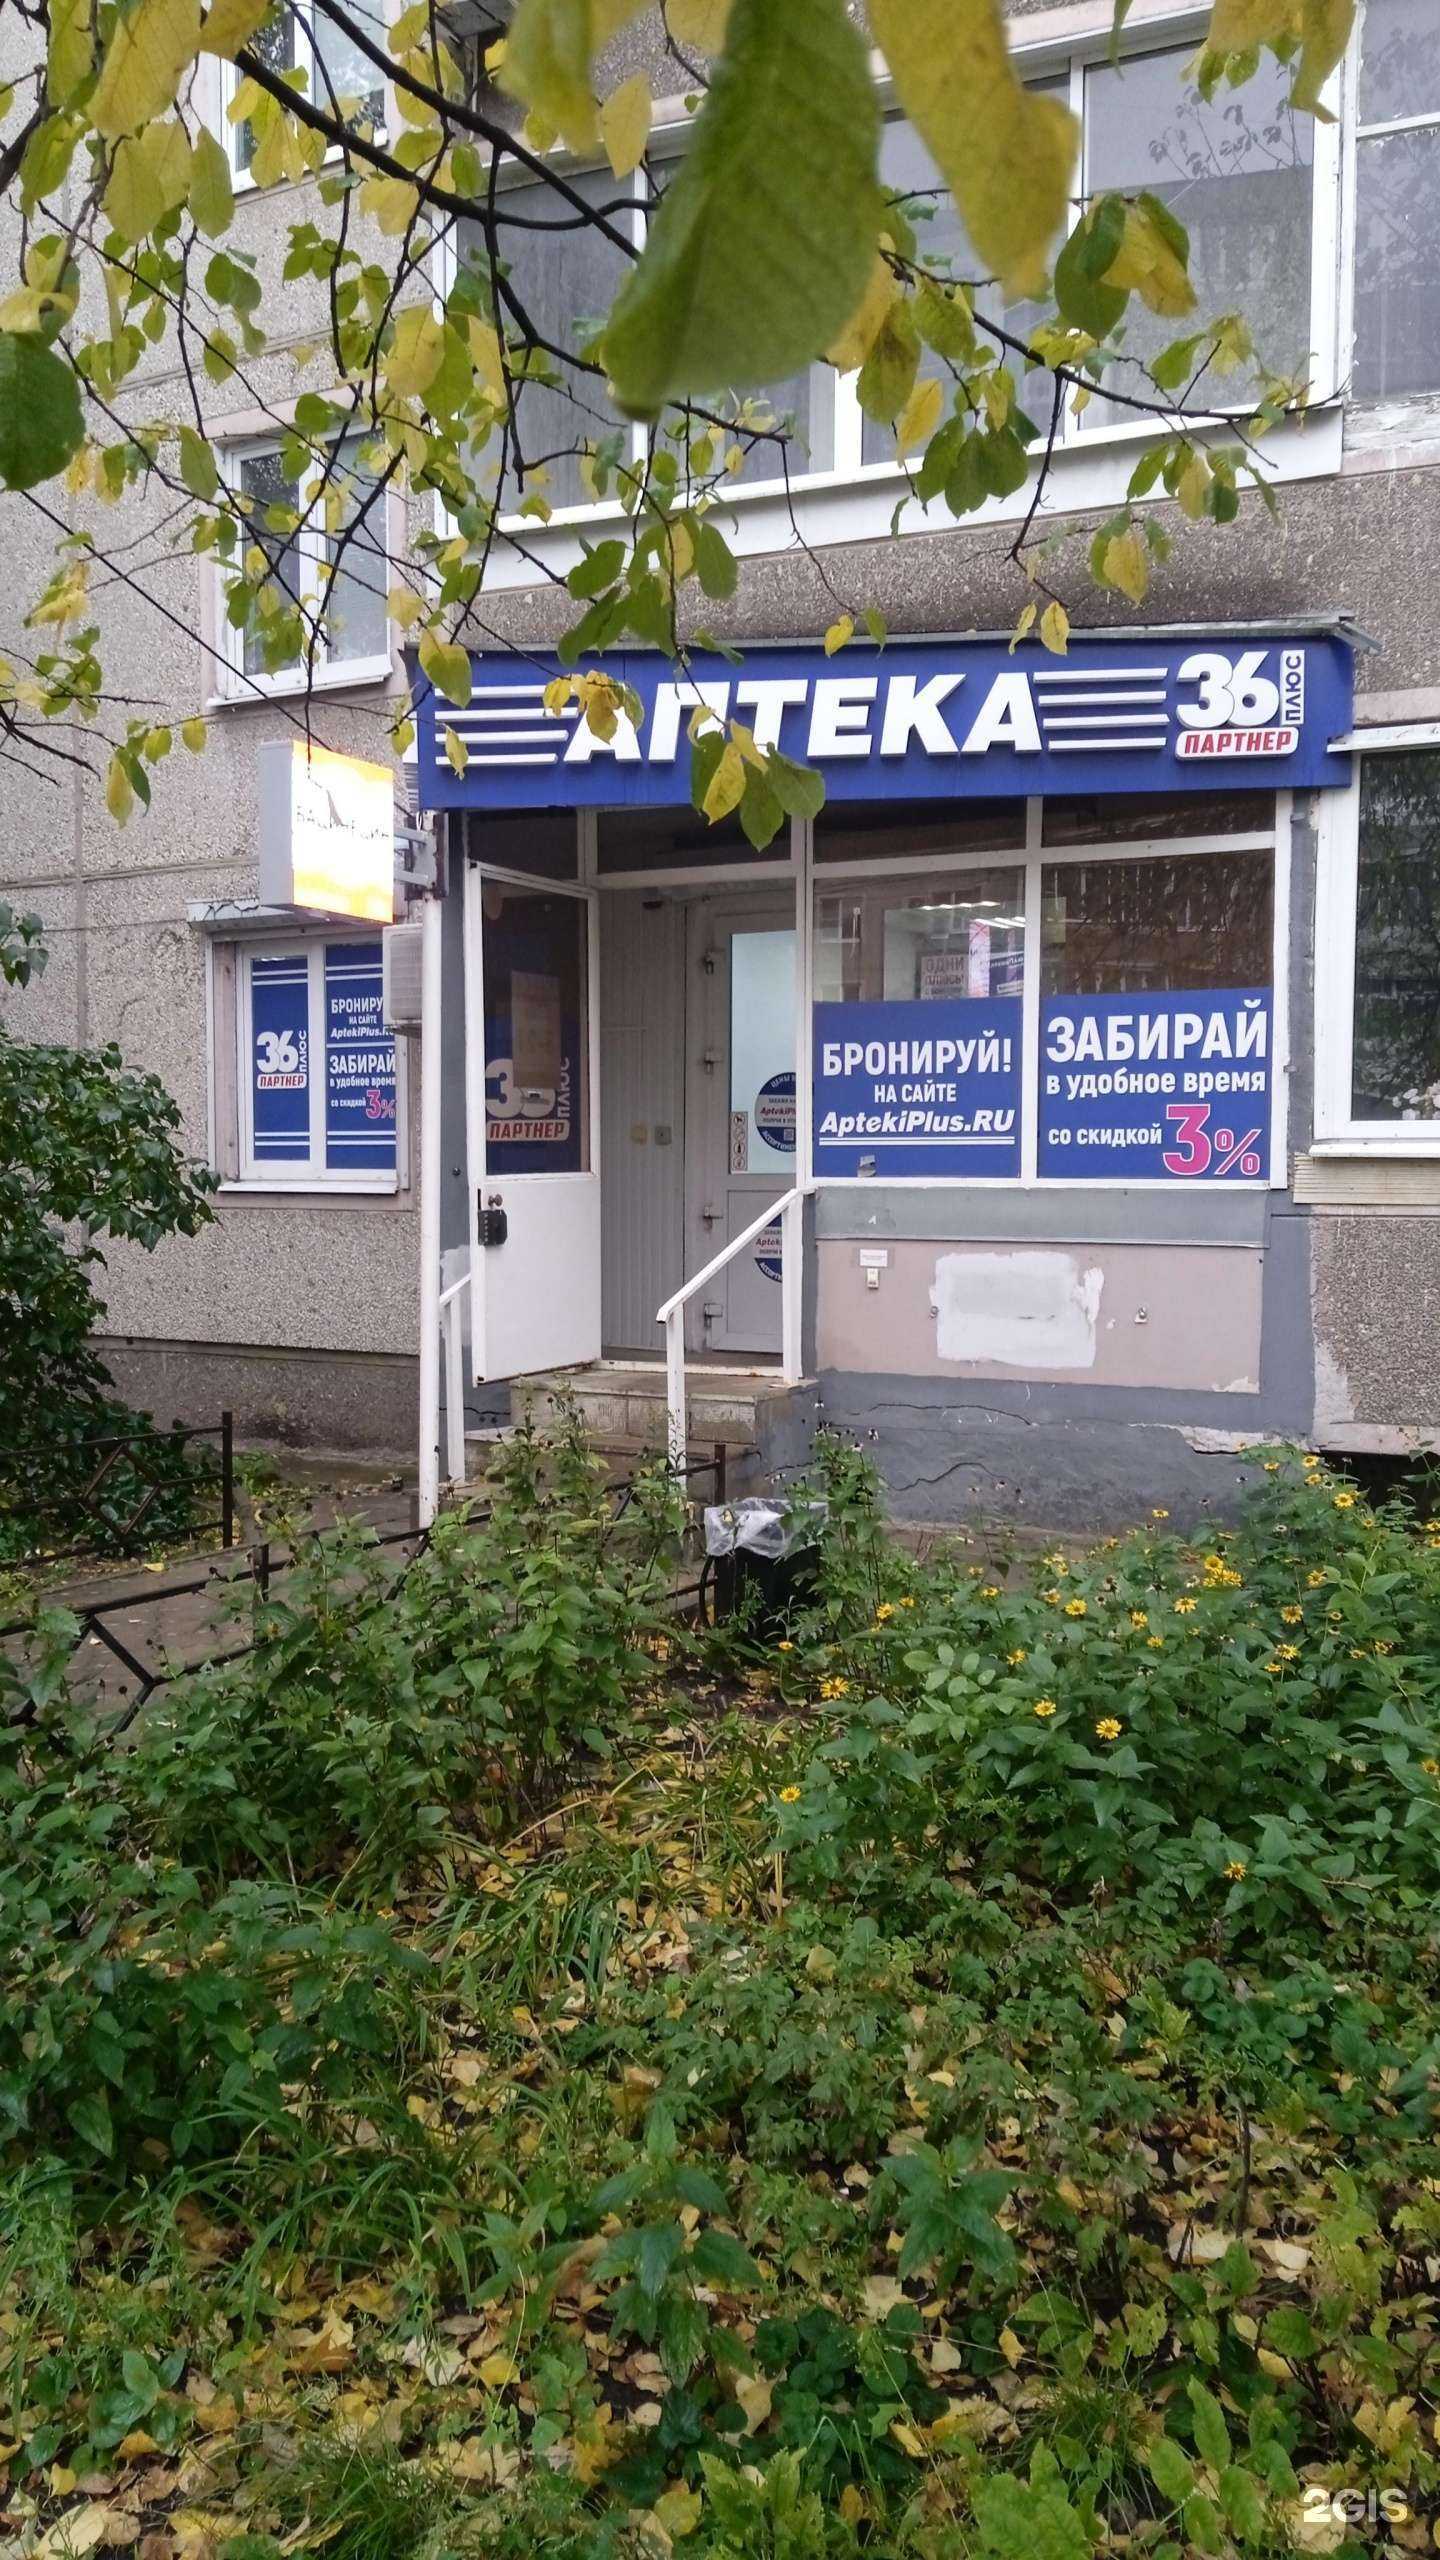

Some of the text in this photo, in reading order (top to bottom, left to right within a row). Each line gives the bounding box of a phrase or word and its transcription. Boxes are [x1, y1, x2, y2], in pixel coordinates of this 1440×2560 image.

[1176, 651, 1280, 729] 36
[1285, 655, 1302, 722] ПЛЮС
[563, 672, 1042, 763] АПТЕКА
[1184, 731, 1292, 754] ПАРТНЕР
[330, 996, 384, 1014] БРОНИРУ
[358, 1014, 377, 1025] САЙТЕ
[1046, 998, 1268, 1063] ЗАБИРАЙ
[256, 1030, 299, 1073] 36
[298, 1029, 307, 1073] ПЛЮС
[329, 1048, 396, 1075] ЗАБИРАЙ
[823, 1029, 1011, 1077] БРОНИРУЙ!
[260, 1075, 304, 1087] ПАРТНЕР
[336, 1075, 370, 1090] удобное
[874, 1079, 957, 1104] НА САЙТЕ
[1046, 1067, 1266, 1101] в удобное время
[365, 1089, 396, 1119] 3%
[489, 1122, 566, 1140] ПАРТНЕР
[819, 1109, 1016, 1138] AptekiPlus.RU
[1048, 1103, 1263, 1176] со скидкой 3%
